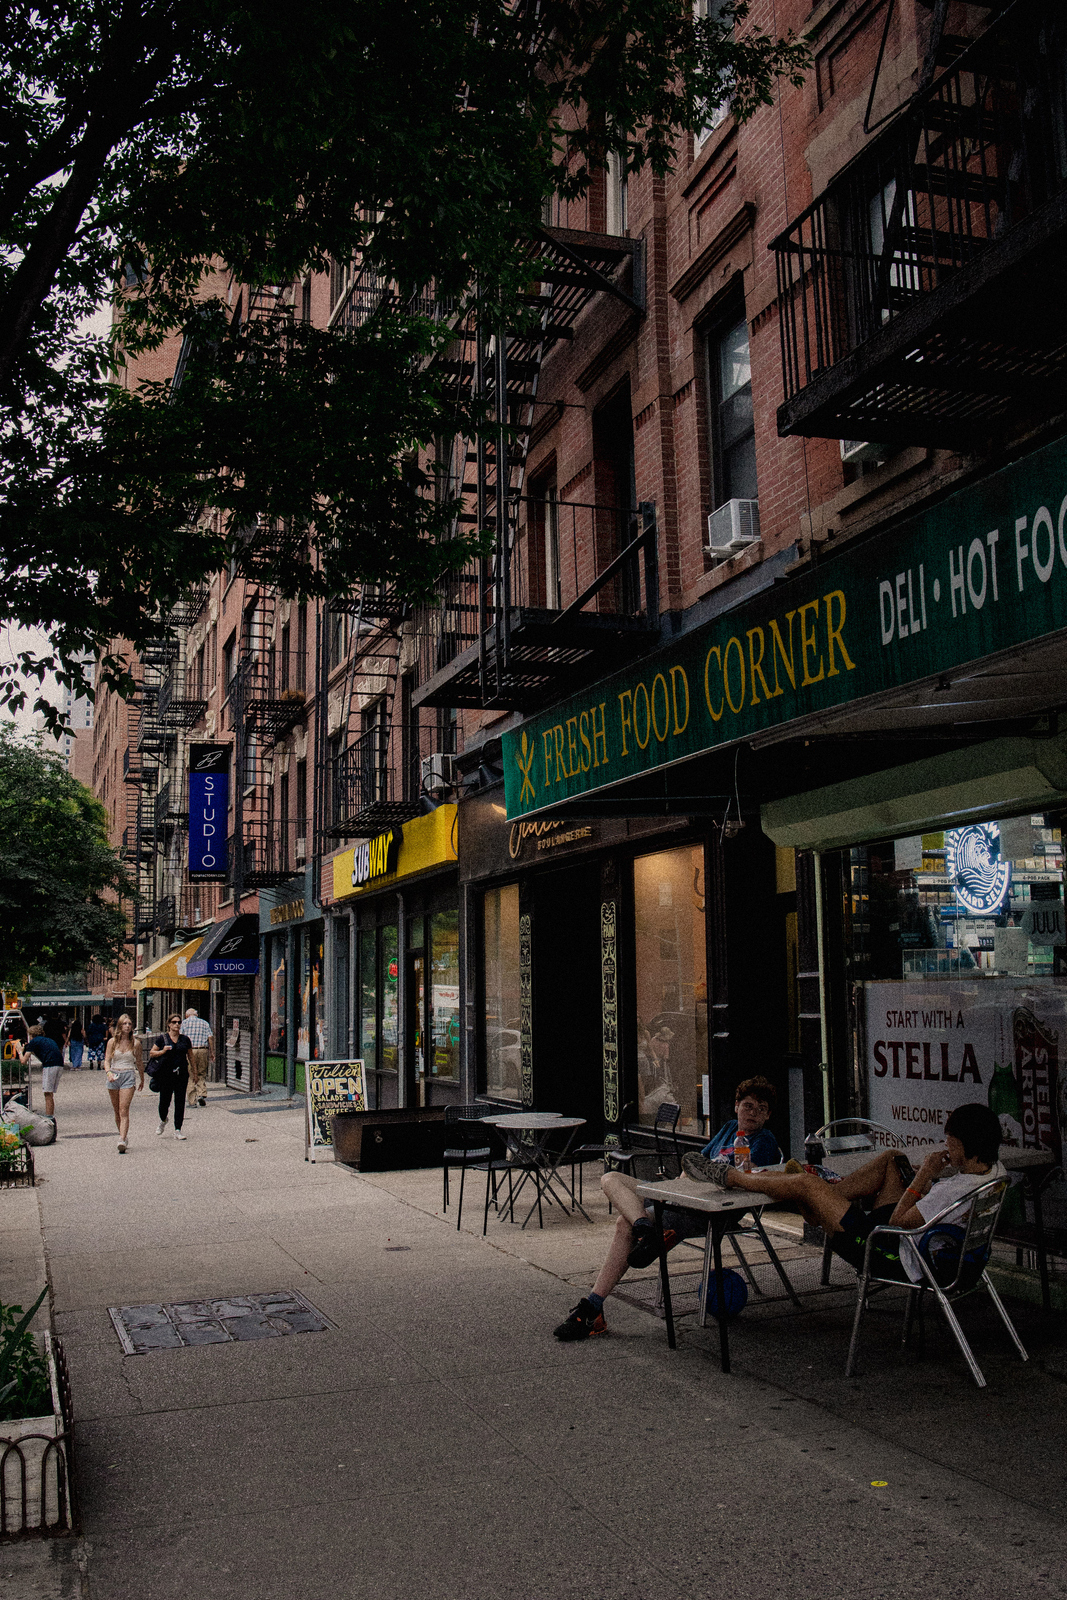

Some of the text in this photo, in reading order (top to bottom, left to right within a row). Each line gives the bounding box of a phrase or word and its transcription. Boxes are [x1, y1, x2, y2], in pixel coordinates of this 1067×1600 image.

[879, 563, 927, 646] DELI
[950, 528, 999, 618] HOT
[542, 589, 856, 787] FRESH FOOD CORNER
[201, 776, 216, 868] STUDIO
[351, 829, 394, 885] SUBWAY
[960, 886, 984, 908] HARD
[1031, 910, 1062, 934] JUUL
[213, 963, 245, 971] STUDIO
[886, 1010, 965, 1029] START WITH A
[873, 1040, 983, 1084] STELLA
[312, 1077, 363, 1096] OPEN
[891, 1105, 943, 1125] WELCOME
